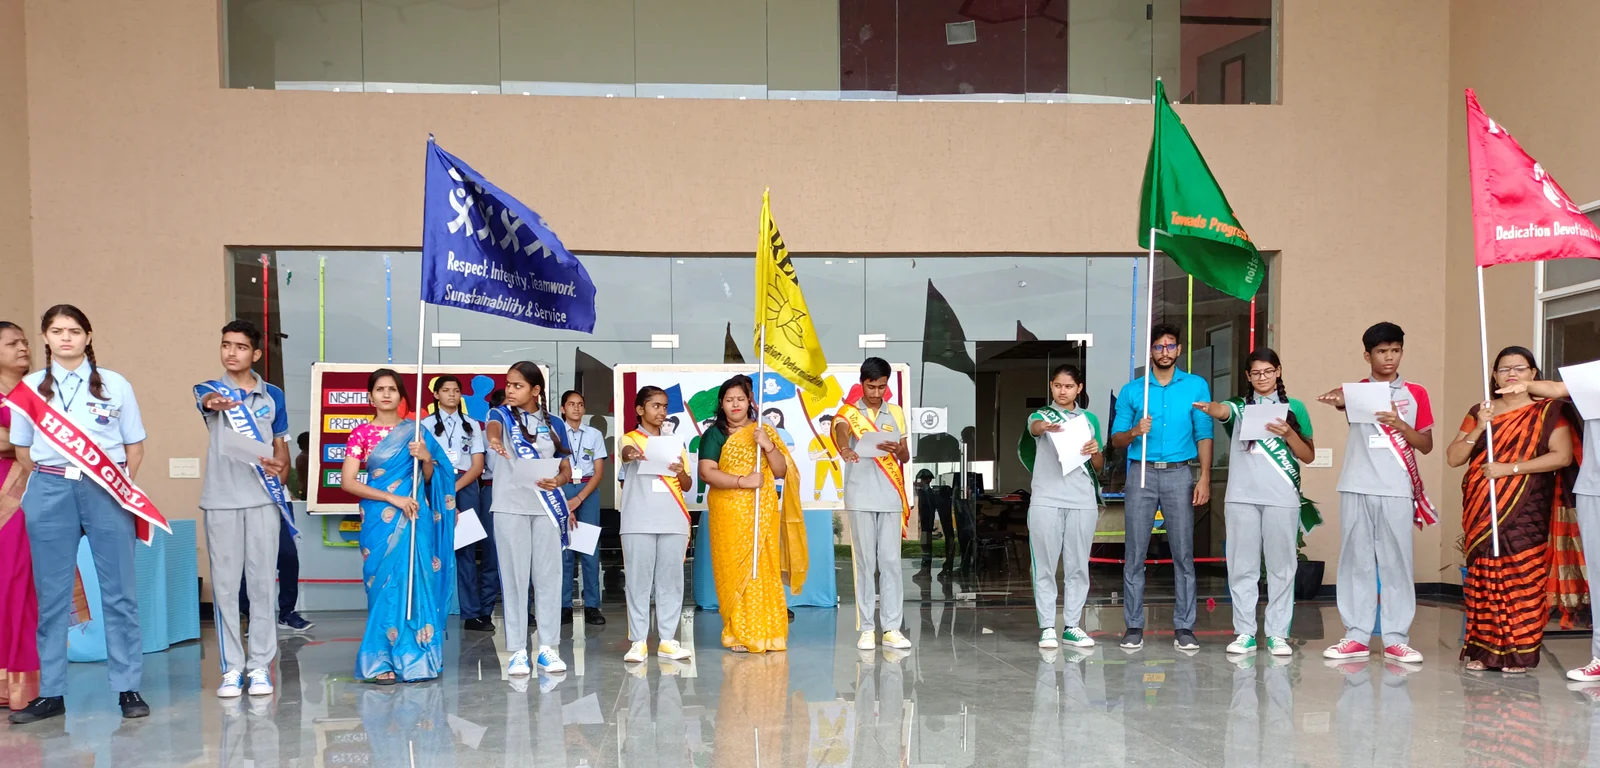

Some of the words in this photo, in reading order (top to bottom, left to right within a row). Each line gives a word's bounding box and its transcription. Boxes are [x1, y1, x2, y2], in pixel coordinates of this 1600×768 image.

[1496, 223, 1551, 241] Dedication
[1554, 222, 1590, 238] Devotion
[447, 251, 489, 279] Respect,
[445, 284, 526, 316] Sunstainability
[525, 303, 534, 318] &
[534, 304, 566, 323] Service
[330, 392, 368, 404] NISHTH
[40, 412, 101, 466] HEAD
[100, 466, 146, 508] GIRL
[546, 491, 564, 516] anskar
